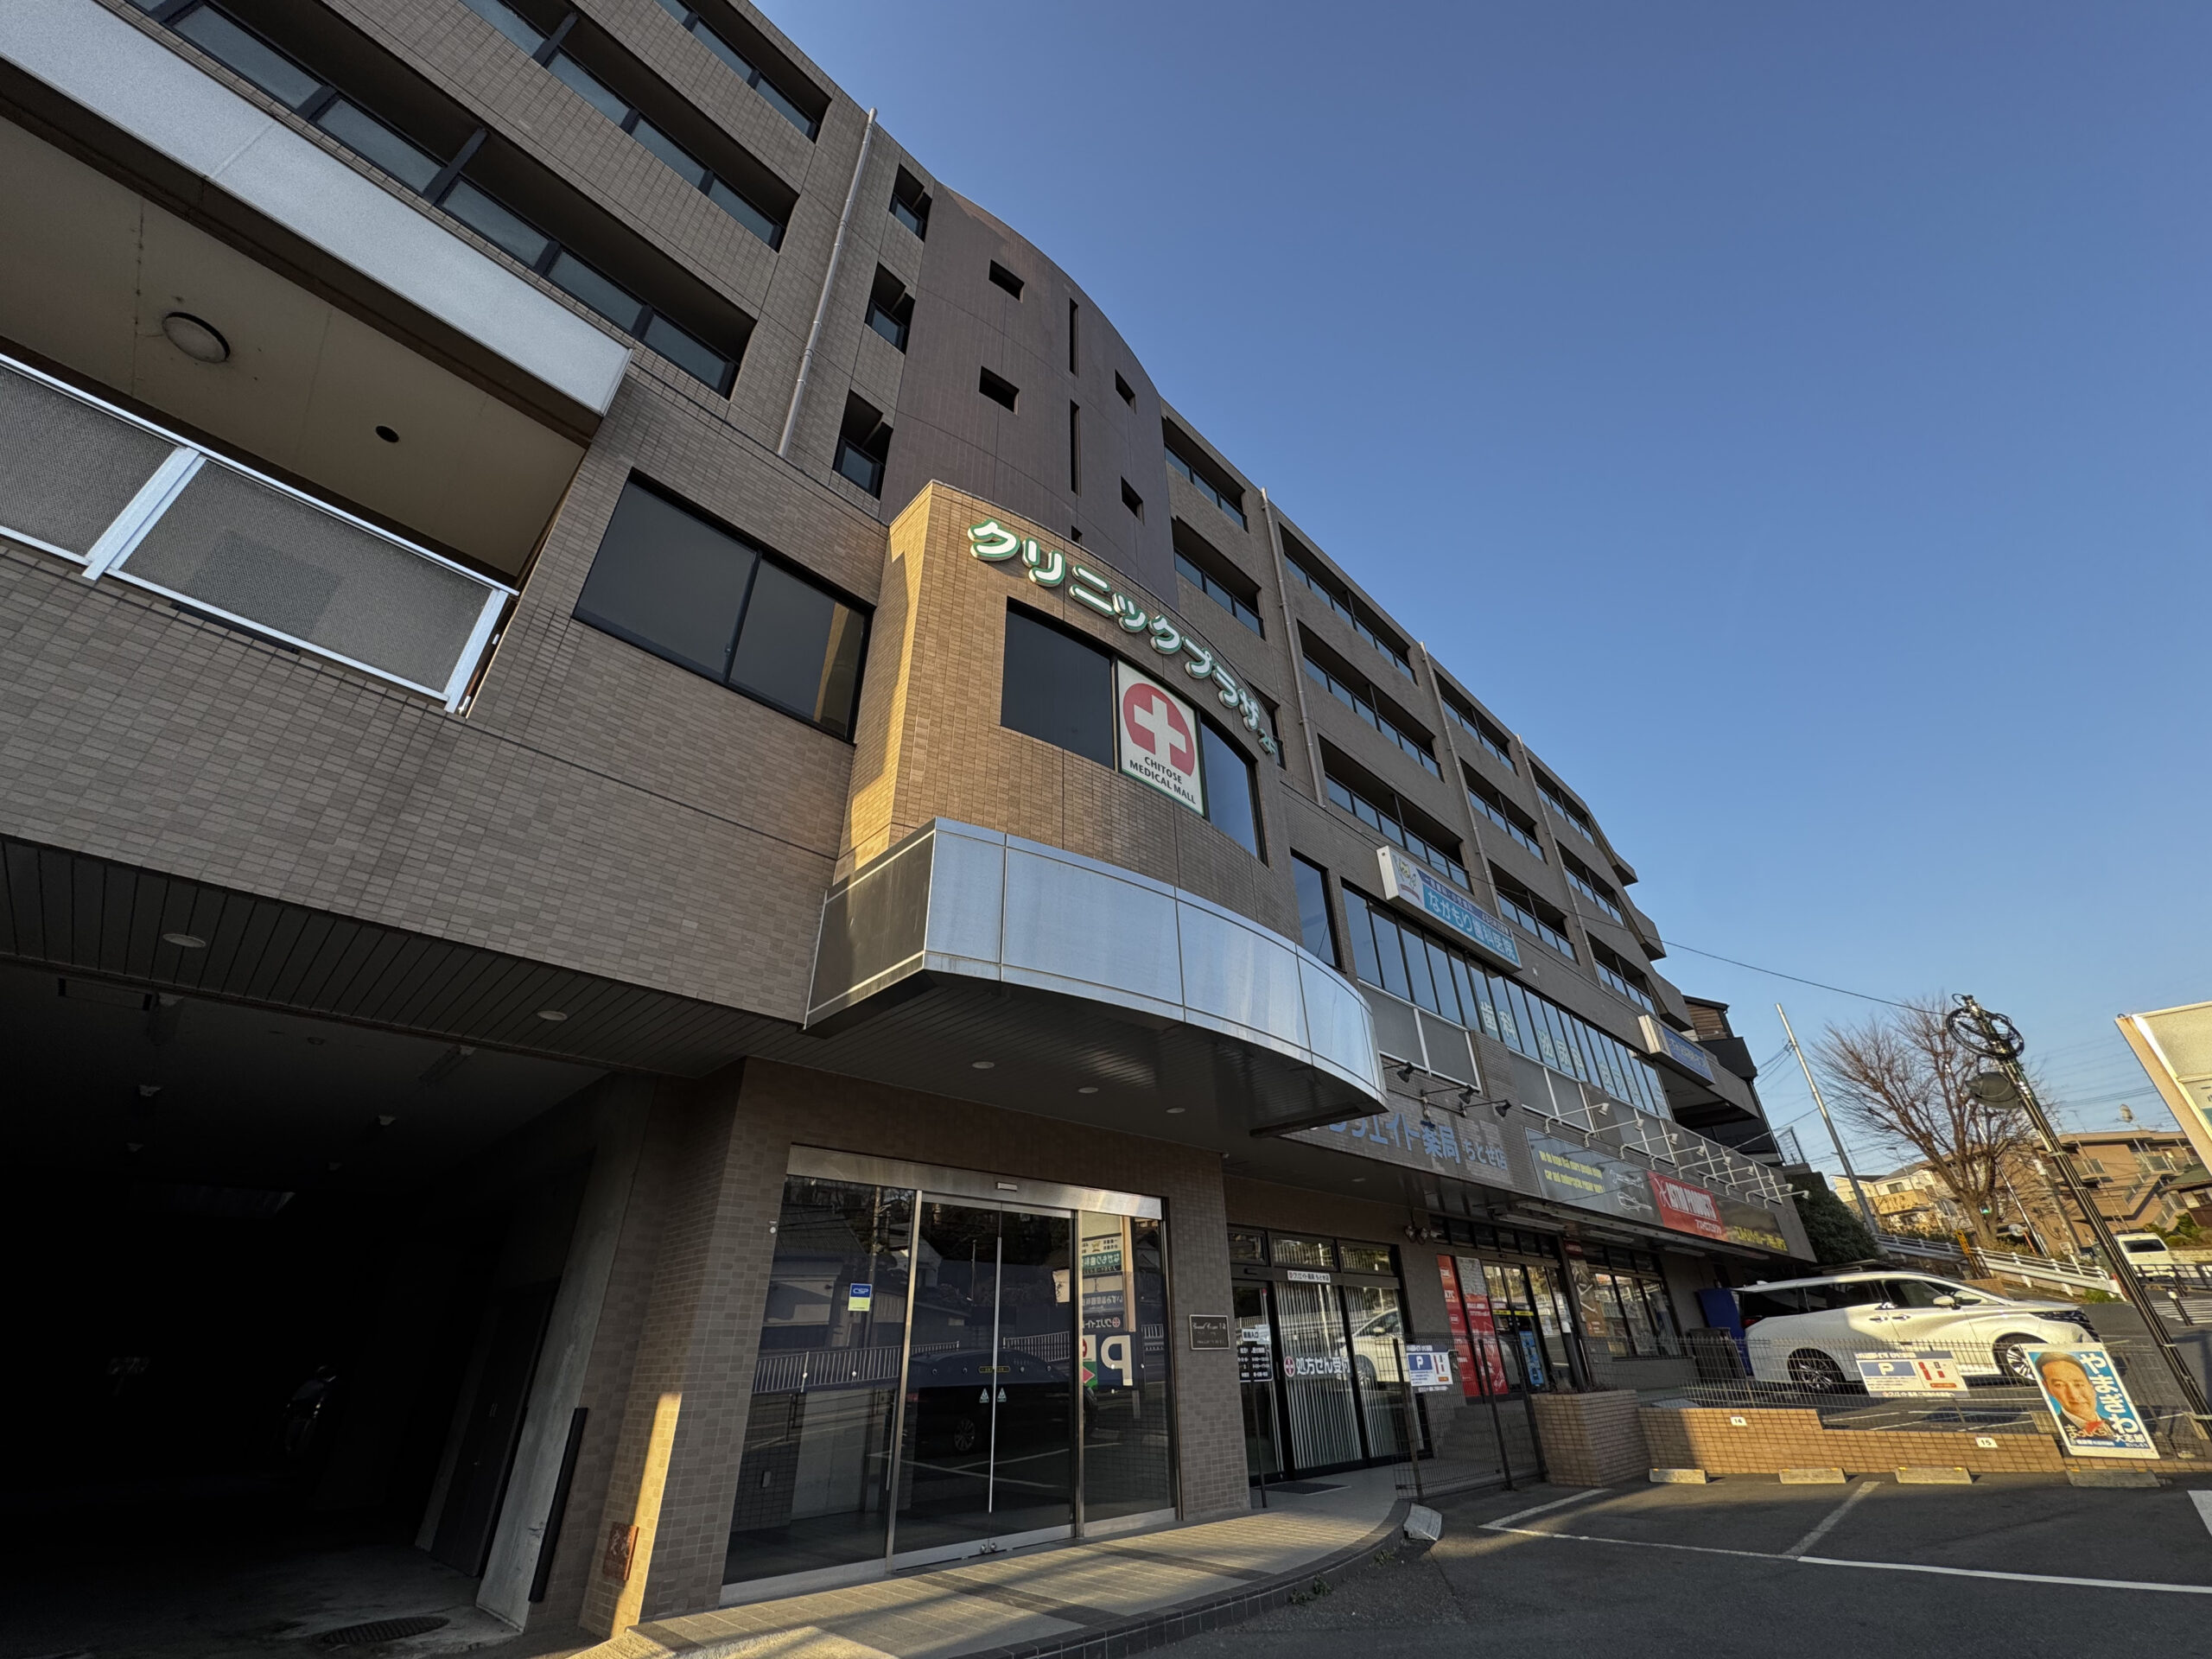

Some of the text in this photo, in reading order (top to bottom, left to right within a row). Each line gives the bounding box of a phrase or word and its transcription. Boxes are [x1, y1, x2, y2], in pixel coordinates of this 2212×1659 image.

[1129, 760, 1196, 804] MEDICAL MALL
[1144, 756, 1182, 785] CHITOSE
[1427, 891, 1516, 961] ながもり歯科医院
[1462, 1139, 1508, 1171] ちとせ店
[1296, 1357, 1351, 1376] 処方せん受付
[1416, 1355, 1424, 1370] P
[1878, 1362, 1895, 1376] P
[2080, 1352, 2139, 1434] やまぎわ
